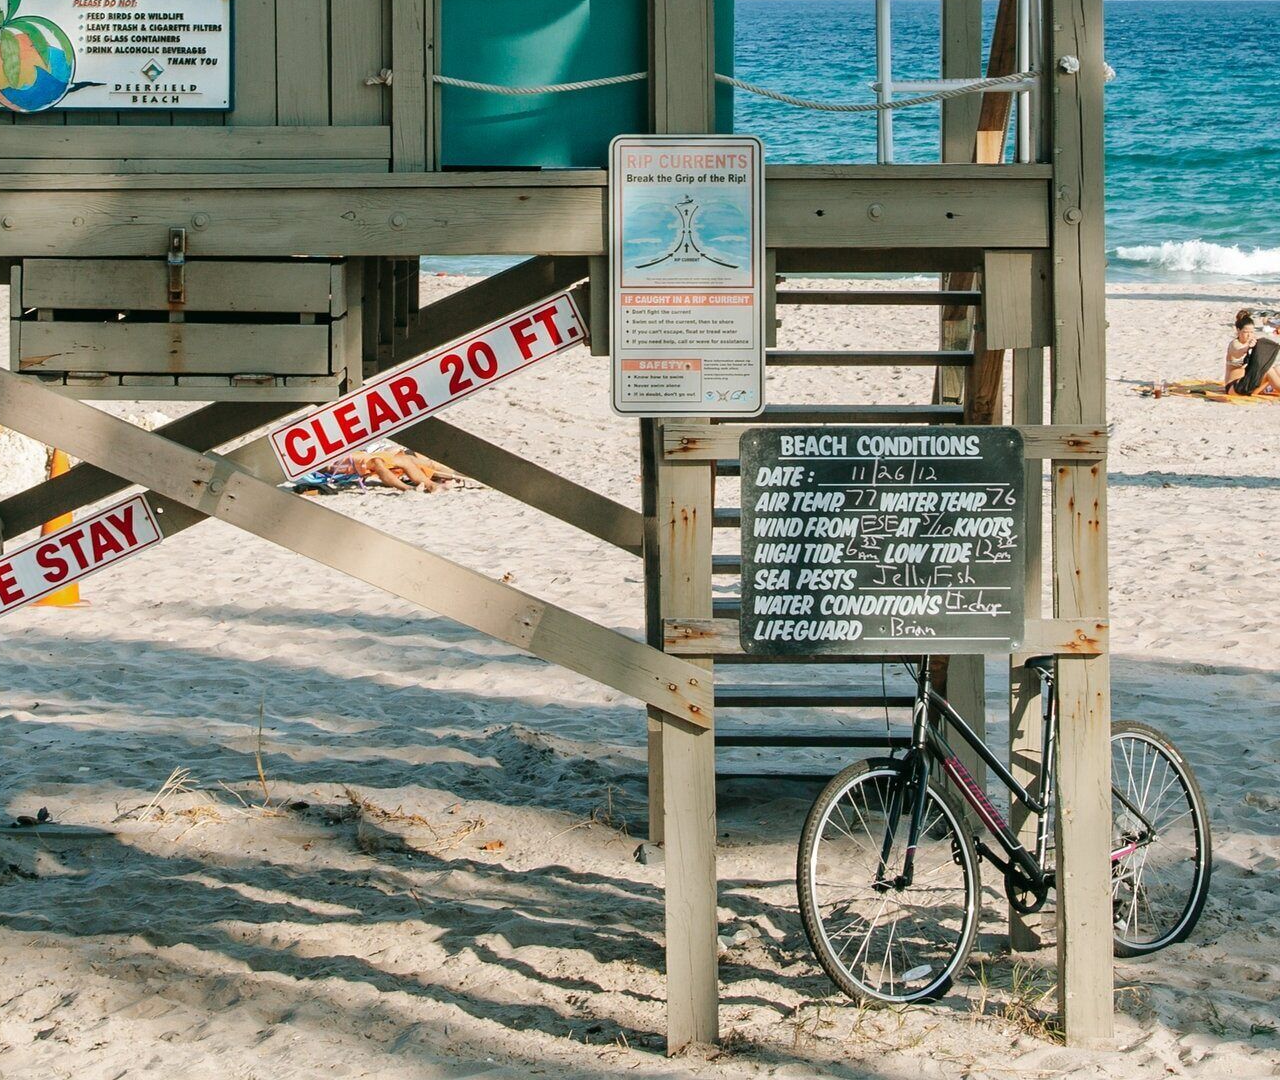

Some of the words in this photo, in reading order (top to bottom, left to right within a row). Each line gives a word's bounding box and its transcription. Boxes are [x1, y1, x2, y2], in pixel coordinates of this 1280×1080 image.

[73, 0, 102, 8] PLEASE
[103, 0, 117, 8] DO
[118, 0, 138, 8] NOT:
[86, 24, 111, 32] LEAVE
[113, 24, 138, 32] TRASH
[141, 24, 147, 32] &
[149, 24, 191, 32] CIGARETTE
[193, 24, 222, 32] FILTERS
[115, 84, 198, 92] DEERFIELD
[626, 154, 653, 169] RIP
[659, 154, 748, 169] CURRENTS
[626, 174, 654, 182] Break
[658, 174, 673, 182] the
[675, 174, 695, 184] Grip
[698, 174, 707, 182] of
[710, 174, 725, 182] the
[728, 174, 746, 184] Rip!
[625, 296, 633, 304] IF
[635, 296, 671, 304] CAUGHT
[673, 296, 681, 304] IN
[684, 296, 692, 304] A
[693, 296, 707, 304] RIP
[709, 296, 750, 304] CURRENT
[640, 361, 683, 370] SAFETY
[283, 374, 428, 470] CLEAR
[440, 340, 498, 396] 20
[510, 304, 579, 364] FT.
[780, 436, 847, 456] BEACH
[856, 436, 980, 456] CONDITIONS
[754, 492, 790, 512] AIR
[792, 492, 846, 513] TEMP.
[846, 490, 877, 506] 77
[880, 492, 939, 512] WATER
[940, 492, 988, 513] TEMP.
[986, 488, 1017, 506] 76
[754, 517, 804, 538] WIND
[804, 517, 860, 538] FROM
[861, 515, 899, 533] ESE
[896, 518, 921, 538] AT
[953, 517, 1014, 538] KNOTS
[35, 504, 144, 583] STAY
[754, 544, 802, 564] HIGH
[803, 544, 845, 564] TIDE
[884, 544, 930, 564] LOW
[930, 542, 973, 563] TIDE
[754, 570, 789, 590] SEA
[796, 569, 857, 590] PESTS
[754, 595, 815, 615] WATER
[820, 595, 942, 616] CONDITIONS
[754, 620, 863, 641] LIFEGUARD
[890, 617, 936, 637] Brian
